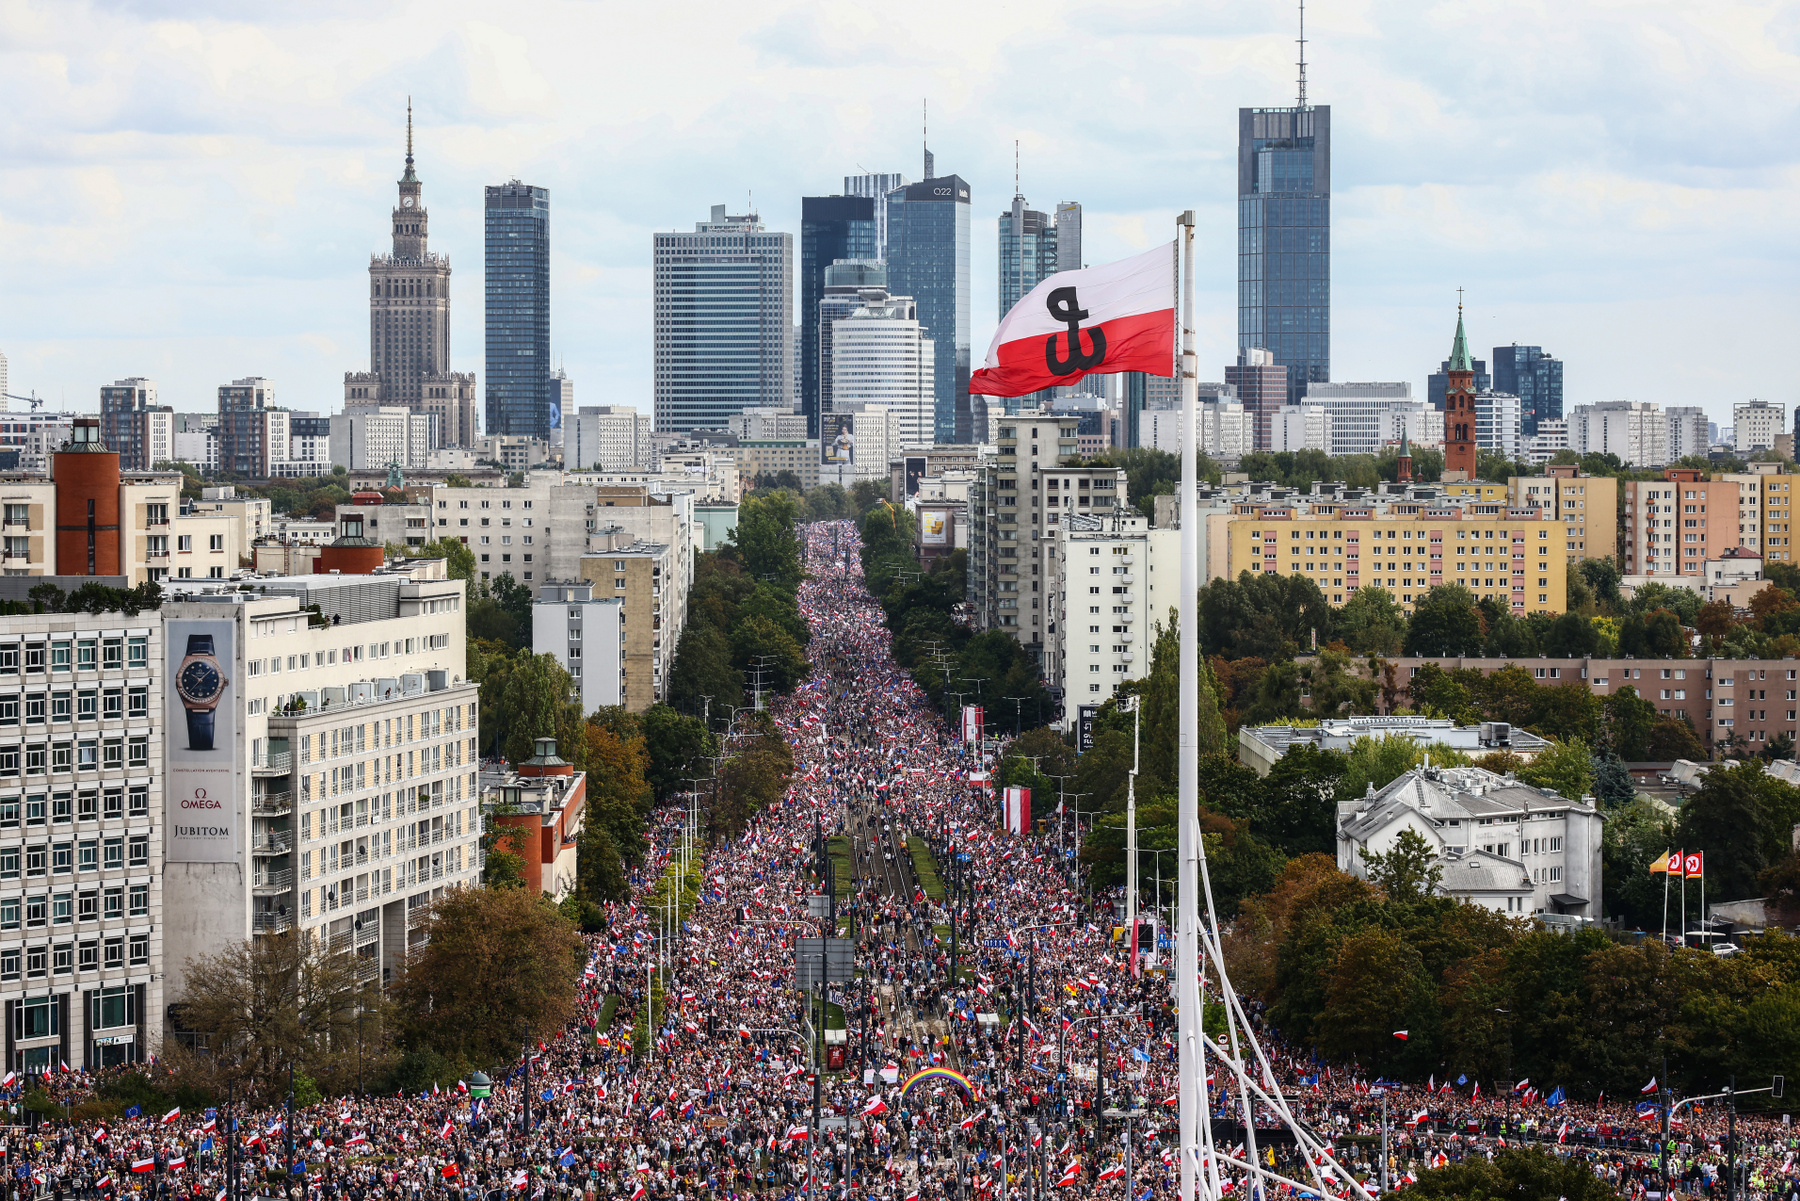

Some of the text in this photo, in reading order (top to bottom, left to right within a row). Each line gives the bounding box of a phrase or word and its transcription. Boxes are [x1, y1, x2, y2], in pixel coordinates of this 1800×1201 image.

[933, 187, 952, 196] Q22
[180, 800, 222, 809] OMEGA
[174, 824, 229, 838] JUBITOM
